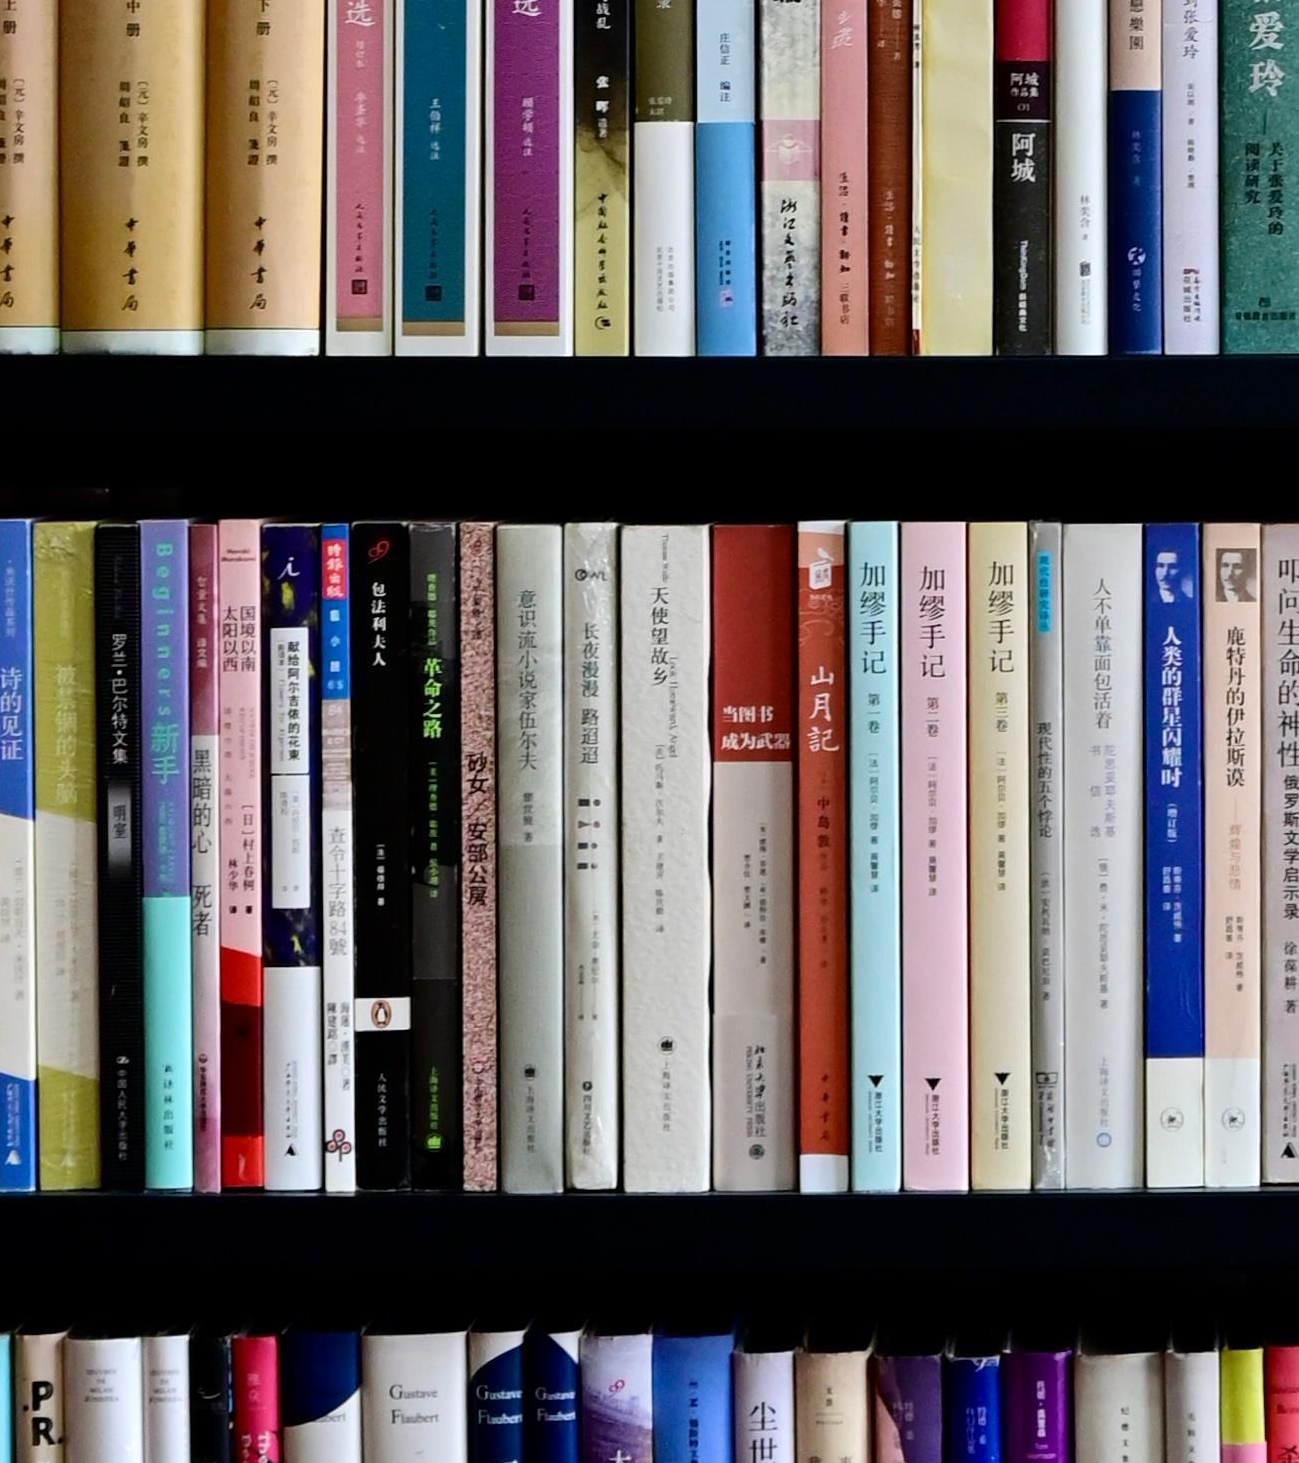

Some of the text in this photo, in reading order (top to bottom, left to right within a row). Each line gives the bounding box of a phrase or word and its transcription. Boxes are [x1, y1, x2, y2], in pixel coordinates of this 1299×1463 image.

[1011, 132, 1036, 183] 阿城
[371, 581, 387, 667] 包法利夫人
[860, 561, 886, 675] 加缪手记
[919, 565, 946, 678] 加缪手记
[988, 561, 1014, 673] 加缪手记
[720, 732, 792, 751] 成为武器
[722, 705, 774, 724] 当图书
[809, 666, 835, 752] 山月記
[1161, 625, 1183, 788] 人类的群星闪耀时
